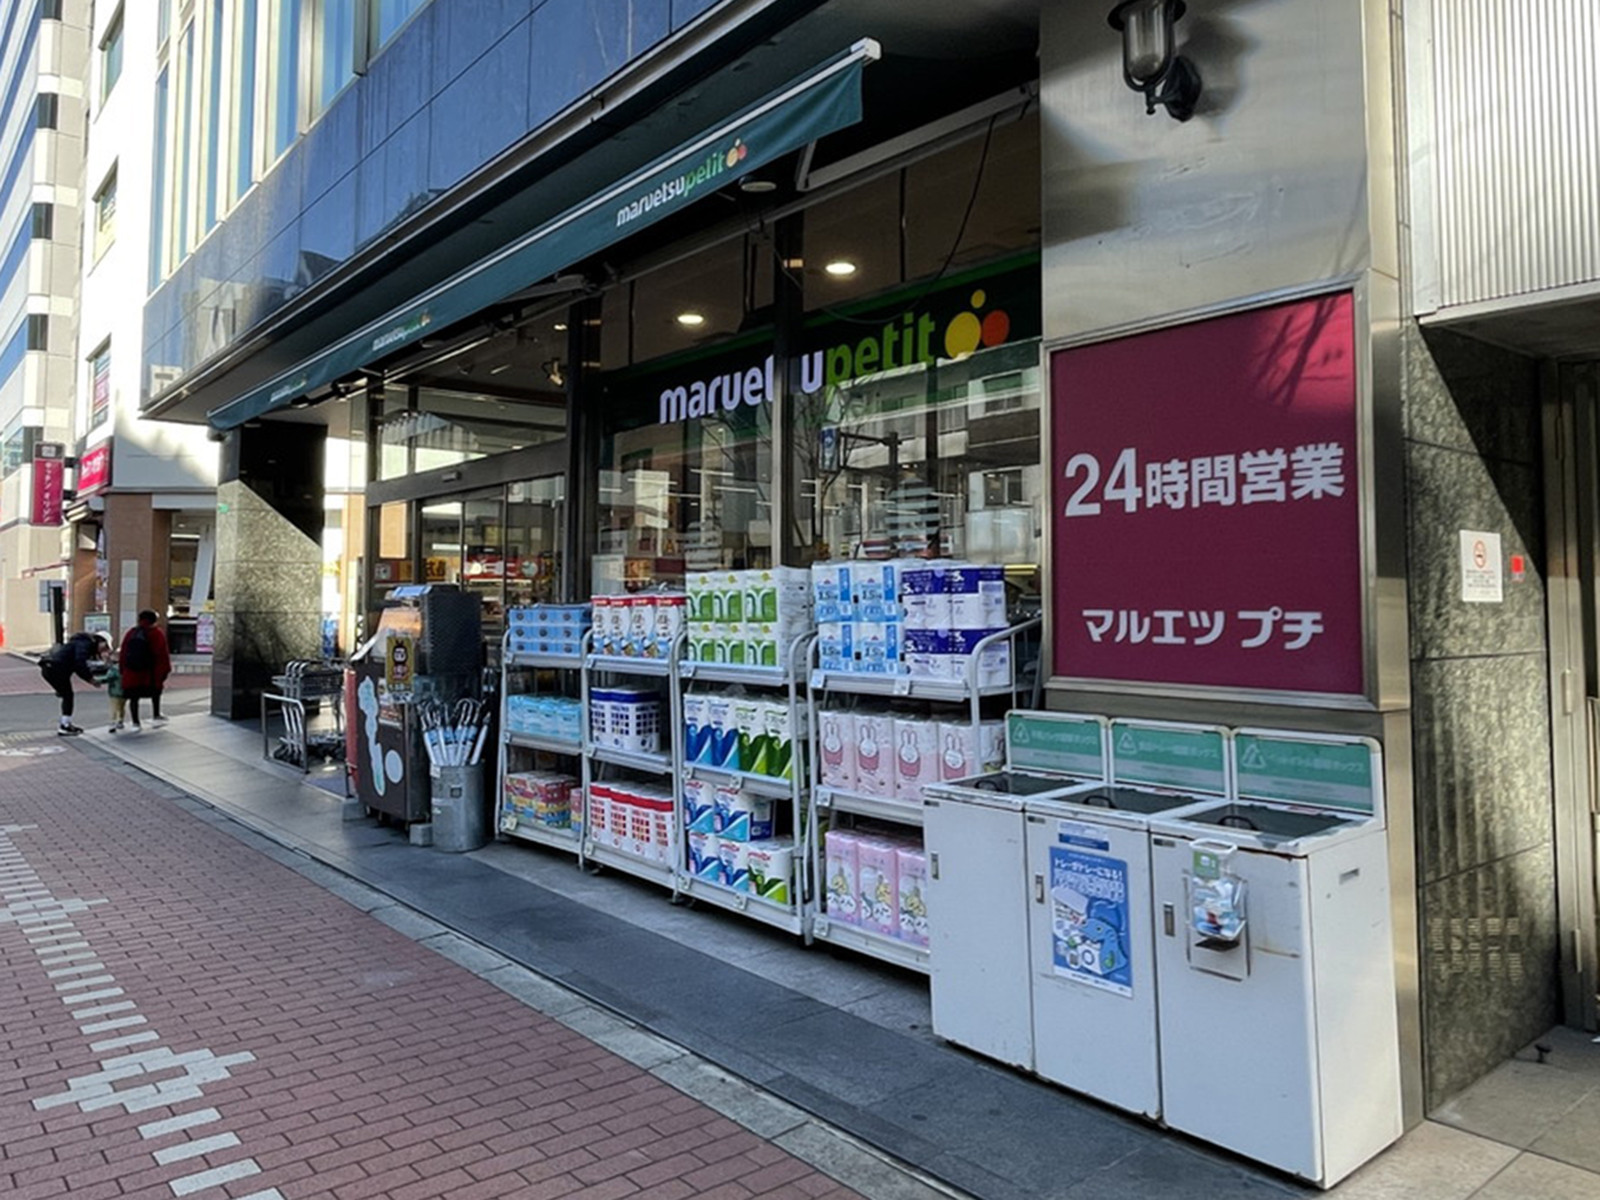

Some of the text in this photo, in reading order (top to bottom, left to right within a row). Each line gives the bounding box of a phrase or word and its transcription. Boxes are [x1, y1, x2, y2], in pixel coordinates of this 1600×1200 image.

[1064, 442, 1345, 517] 24時間営業
[1082, 606, 1324, 650] マルエツ プチ
